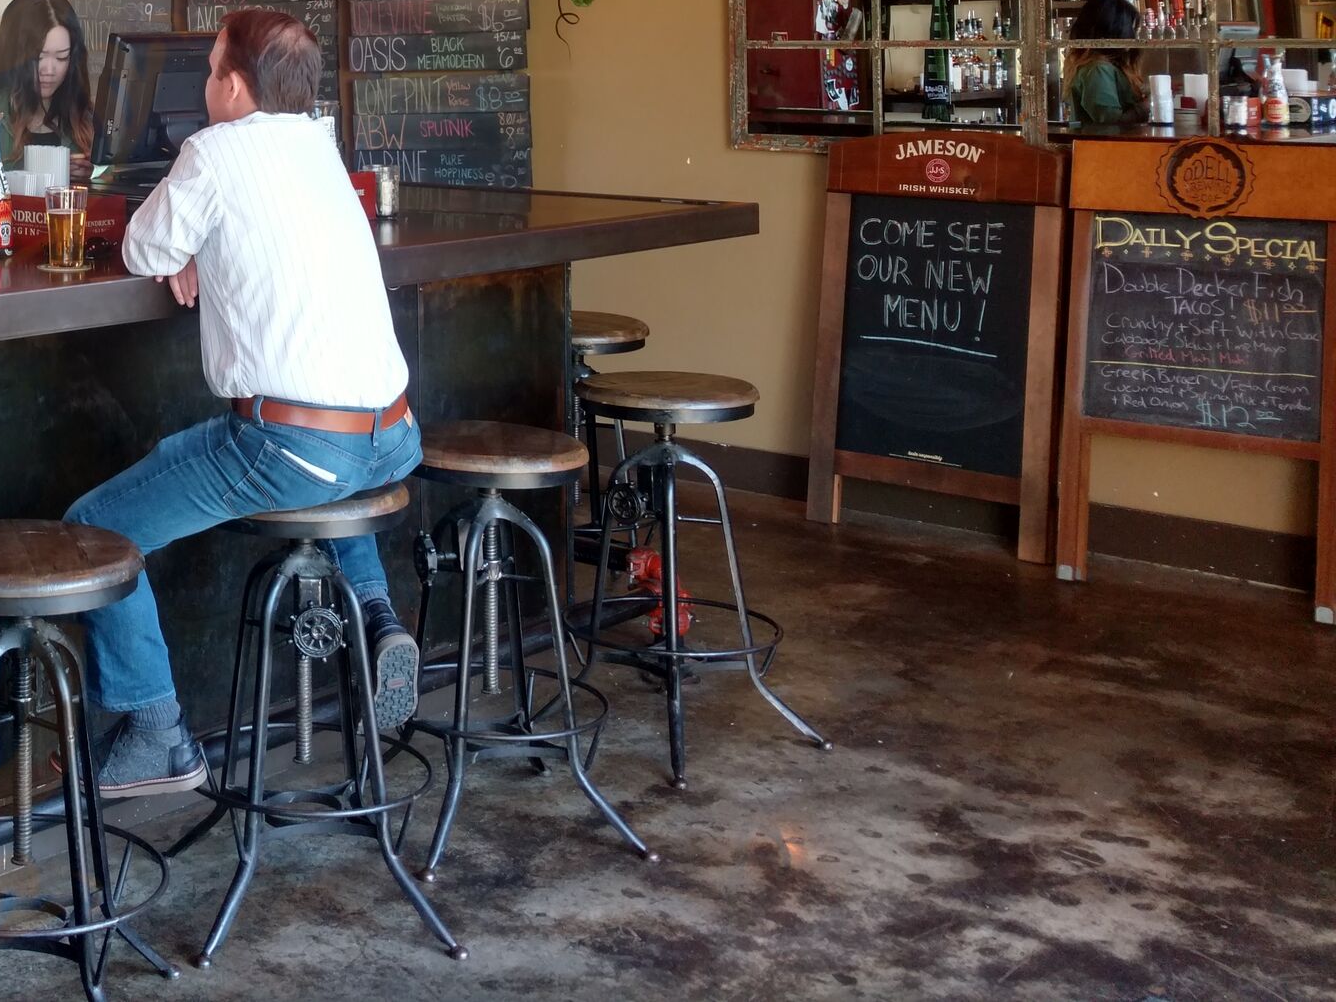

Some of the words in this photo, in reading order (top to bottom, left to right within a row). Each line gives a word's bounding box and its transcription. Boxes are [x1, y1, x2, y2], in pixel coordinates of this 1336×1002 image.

[350, 36, 407, 72] OASIS
[430, 37, 465, 52] BLACK
[417, 54, 485, 71] METAMODERN
[354, 77, 399, 115] LONE
[403, 75, 447, 113] PINT
[355, 114, 406, 151] ABW
[419, 119, 475, 138] SPUTNIK
[440, 153, 465, 165] PURE
[895, 139, 983, 164] JAMESON
[433, 167, 484, 179] HOPPINESS
[898, 183, 926, 193] IRISH
[929, 185, 976, 196] WHISKEY
[17, 226, 37, 236] GIN
[859, 217, 937, 249] COME
[947, 221, 1006, 255] SEE
[857, 254, 913, 286] OUR
[924, 259, 993, 296] NEW
[1103, 262, 1170, 295] Double
[1176, 267, 1246, 298] Decker
[1252, 271, 1303, 302] Fish
[1106, 311, 1174, 337] Crunchy
[1189, 318, 1233, 337] Soft
[1123, 393, 1147, 408] Red
